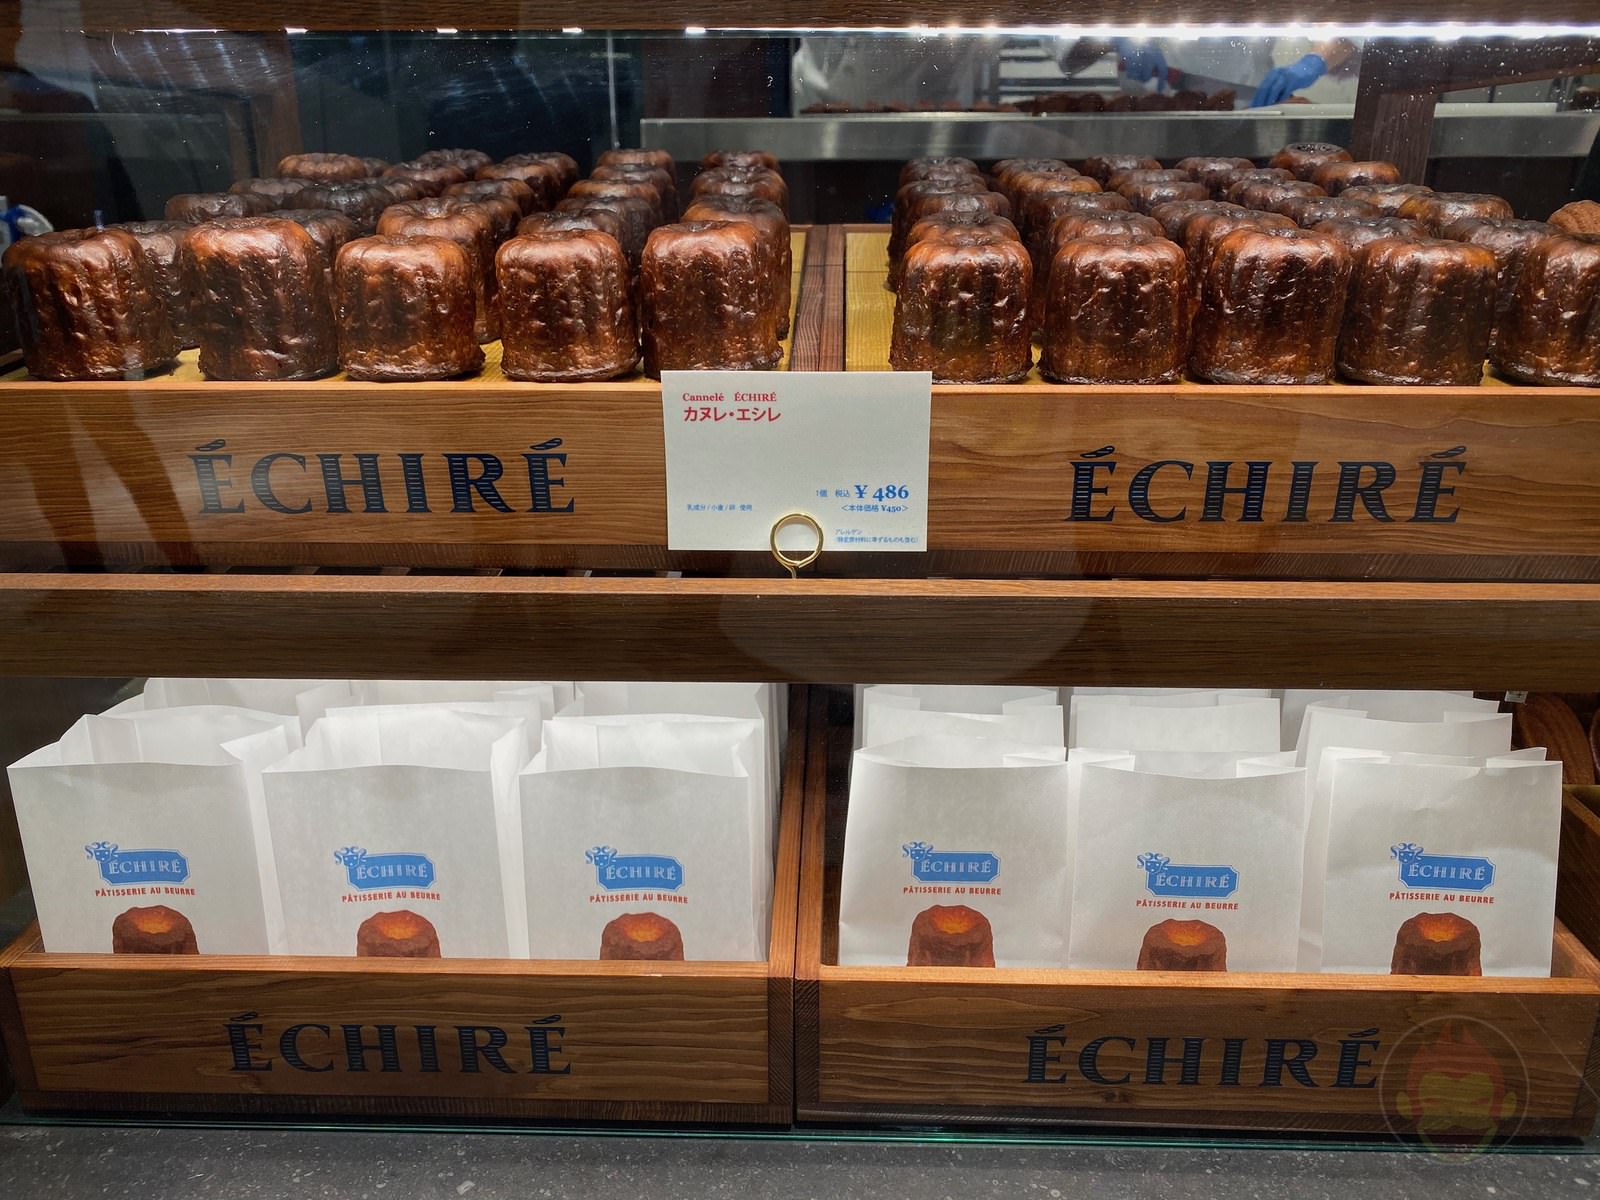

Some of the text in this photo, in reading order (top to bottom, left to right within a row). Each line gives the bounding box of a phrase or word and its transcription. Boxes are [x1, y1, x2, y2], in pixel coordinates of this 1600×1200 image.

[683, 391, 777, 402] Cannelé ÉCHIRÉ
[684, 407, 781, 422] カヌレ・エシレ
[187, 438, 575, 514] ÉCHIRÉ
[1064, 445, 1468, 523] ÉCHIRÉ
[108, 859, 181, 874] ÉCHIRÉ
[356, 863, 428, 880] ÉCHIRÉ
[606, 865, 677, 881] ÉCHIRÉ
[920, 860, 992, 873] ÉCHIRÉ
[1408, 862, 1485, 881] ÉCHIRÉ
[1155, 872, 1230, 888] ÉCHIRÉ
[96, 887, 147, 897] PÂTISSERIE
[165, 887, 196, 896] BEURRE
[342, 891, 441, 903] PÂTISSERIE AU BEURRE
[903, 886, 952, 894] PÂTISSERIE
[969, 887, 1002, 895] BEURRE
[1390, 892, 1495, 904] PÂTISSERIE AU BEURRE
[590, 894, 640, 903] PÂTISSERIE
[657, 894, 688, 904] BEURRE
[1136, 899, 1187, 908] PÂTISSERIE
[1205, 902, 1239, 910] BEURRE
[222, 1011, 571, 1075] ÉCHIRÉ
[1022, 1024, 1381, 1089] ÉCHIRÉ
